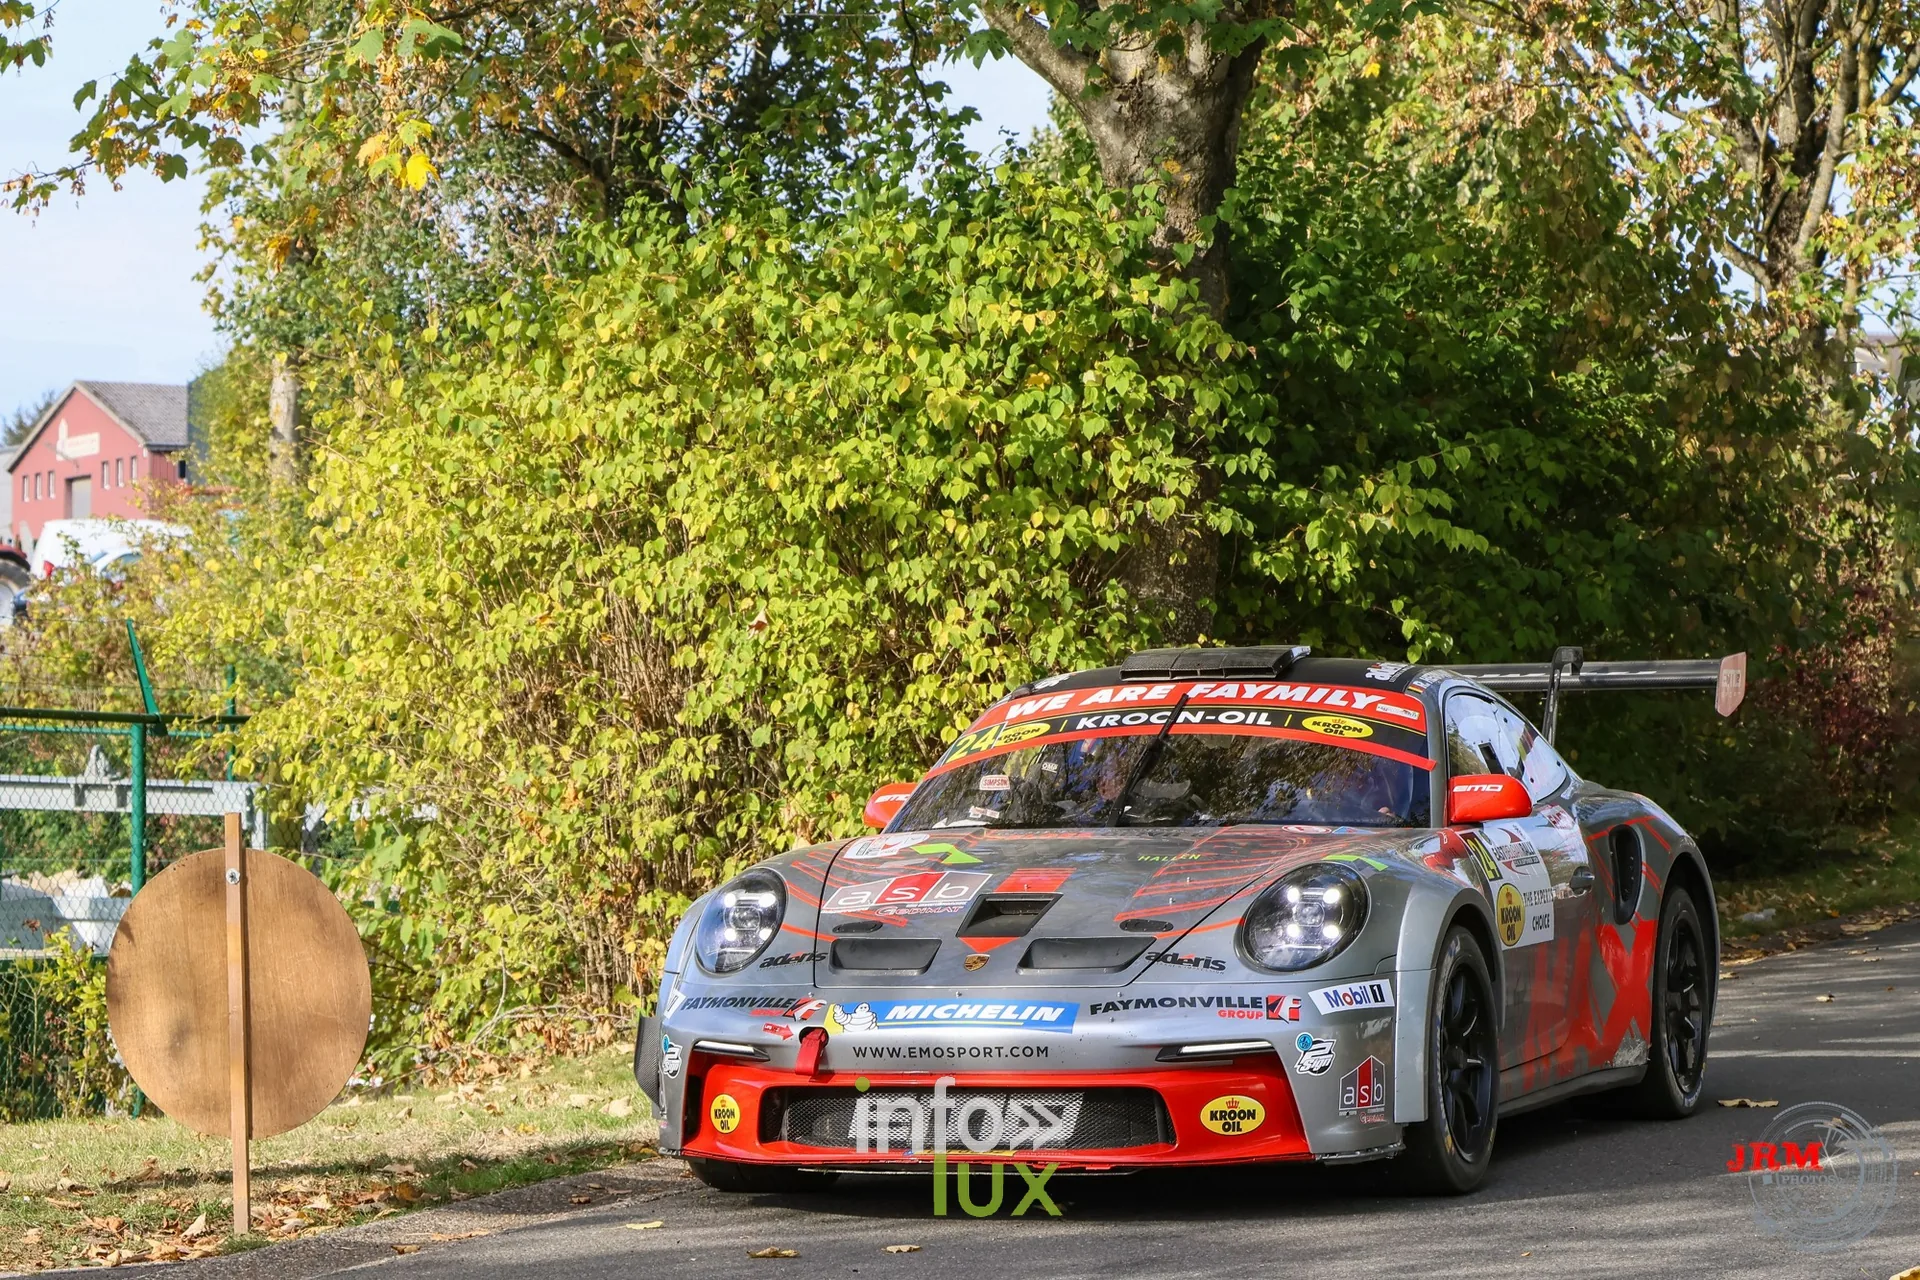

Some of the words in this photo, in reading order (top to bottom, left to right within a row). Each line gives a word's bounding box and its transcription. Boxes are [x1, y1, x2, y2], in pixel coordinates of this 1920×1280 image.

[1005, 693, 1075, 720] WE
[1078, 684, 1176, 706] ARE
[1187, 683, 1386, 710] FAYMILY
[1311, 720, 1364, 734] KROON
[1323, 727, 1345, 736] OIL
[946, 725, 1001, 763] 24
[982, 777, 1008, 787] SIMPSON
[1466, 837, 1500, 880] 24
[837, 883, 970, 906] asb
[1500, 905, 1522, 925] KROON
[1532, 913, 1550, 932] CHOICE
[1145, 951, 1227, 972] aderis
[680, 996, 797, 1011] FAYMONVILLE
[1090, 996, 1263, 1016] FAYMONVILLE
[1324, 985, 1371, 1009] Mobil
[884, 1004, 1066, 1023] MICHELIN
[1217, 1009, 1264, 1021] GROUP
[852, 1045, 1050, 1059] WWW.EMOSPORT.COM
[1343, 1078, 1383, 1105] asb
[713, 1108, 736, 1120] KROON
[1209, 1109, 1257, 1121] KROON
[720, 1120, 730, 1131] OIL
[1221, 1121, 1243, 1133] OIL
